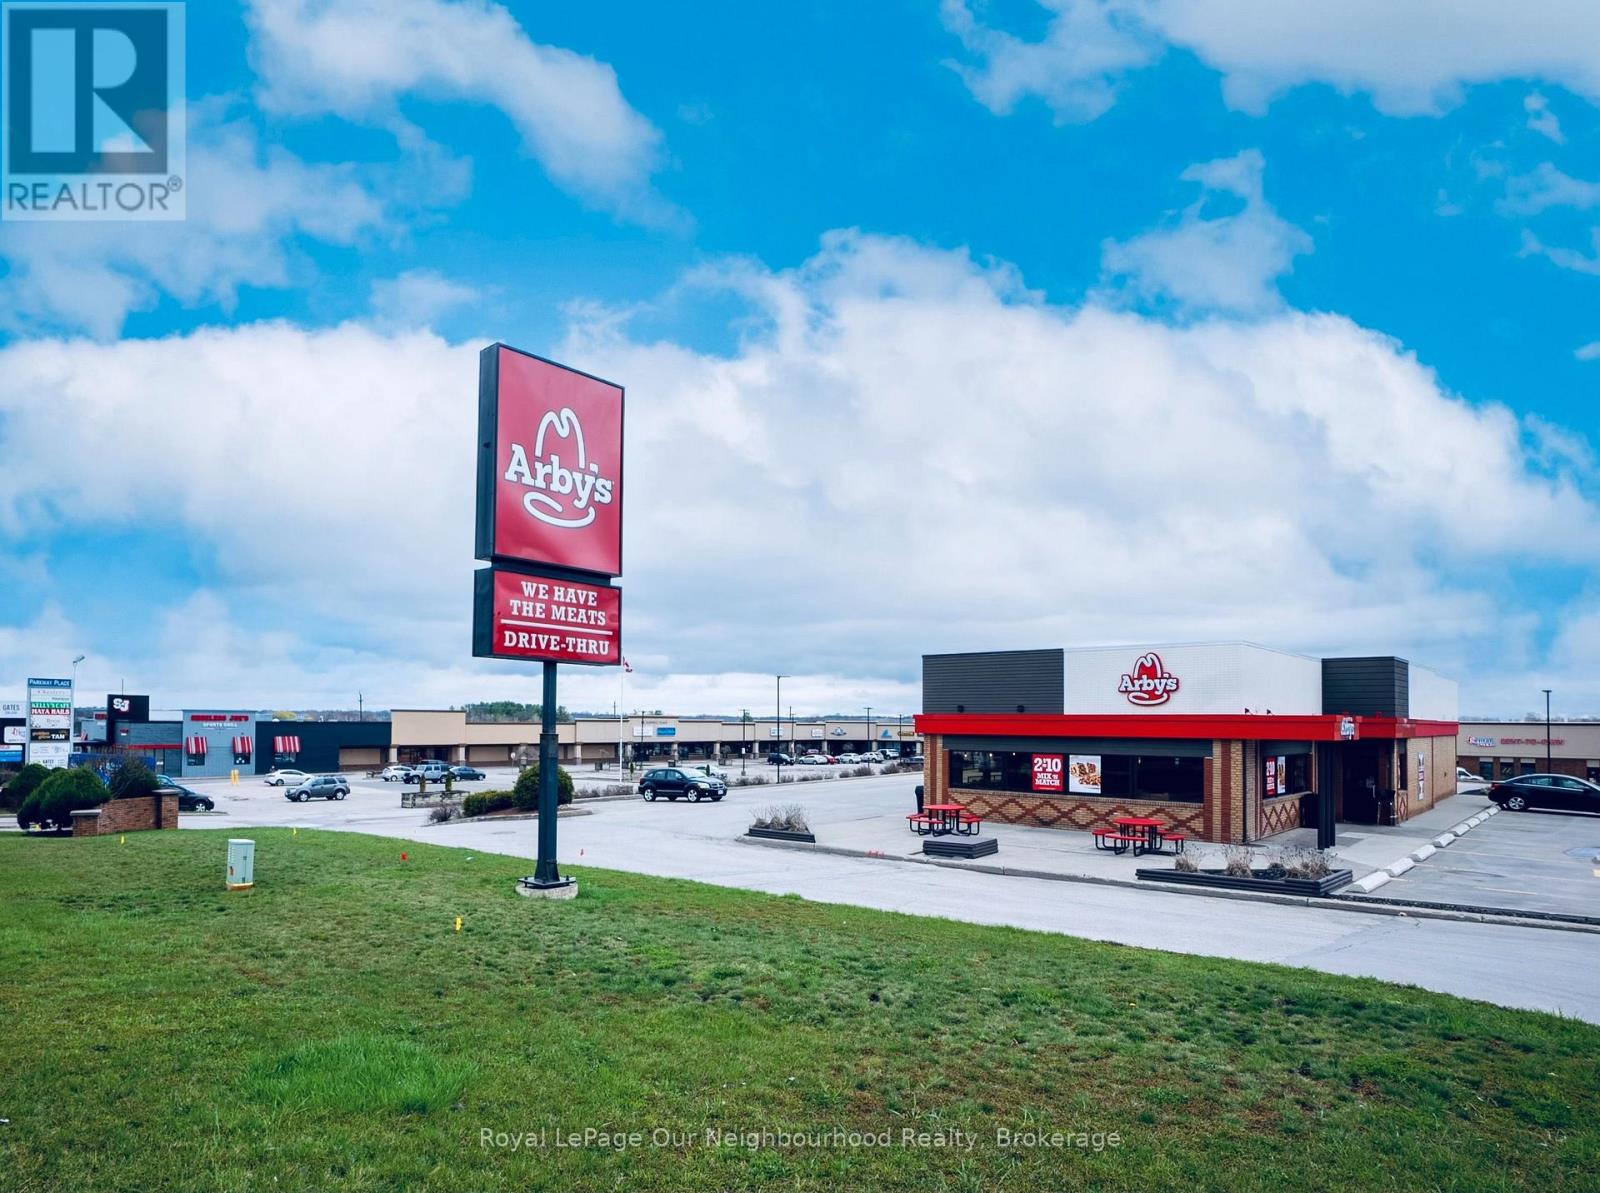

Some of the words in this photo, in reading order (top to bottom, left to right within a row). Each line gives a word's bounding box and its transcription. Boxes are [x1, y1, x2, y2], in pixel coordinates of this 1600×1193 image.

[504, 443, 613, 509] Arby's
[521, 581, 548, 600] WE
[553, 586, 597, 607] HAVE
[510, 600, 545, 619] THE
[551, 605, 606, 626] MEATS
[503, 630, 609, 655] DRIVE-THRU
[1118, 672, 1179, 696] Arby's
[1035, 778, 1060, 786] MATCH
